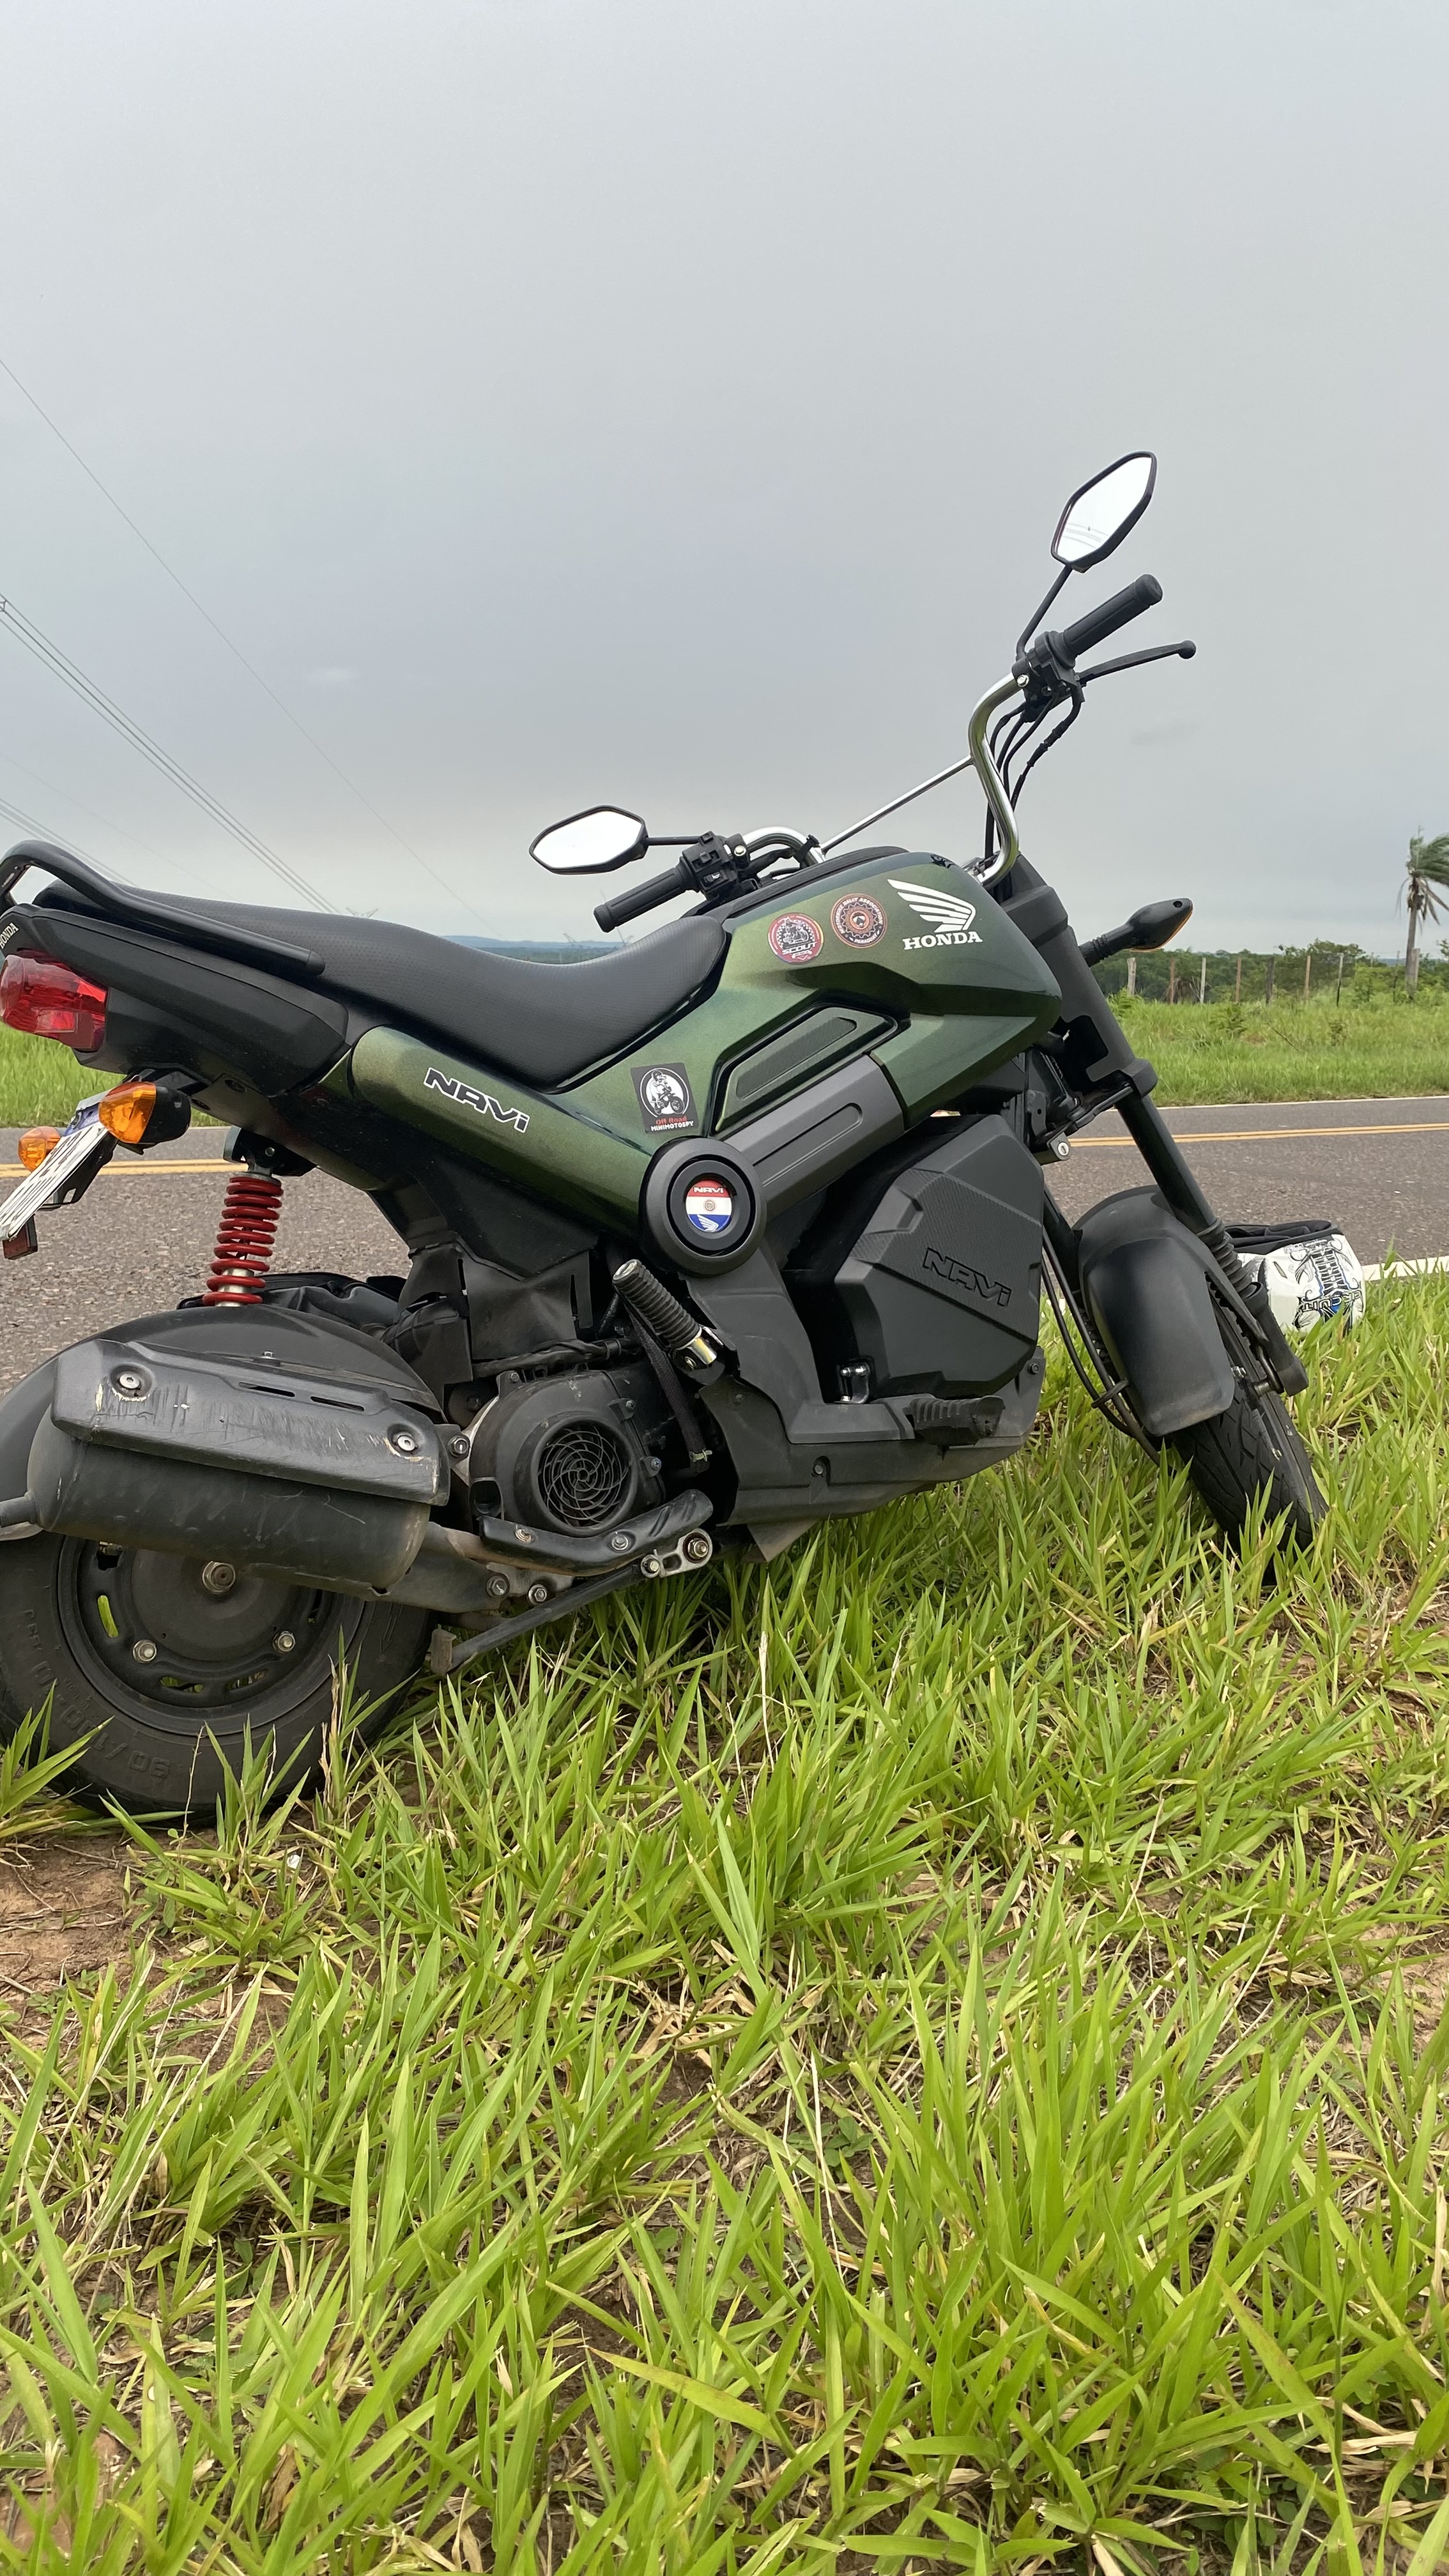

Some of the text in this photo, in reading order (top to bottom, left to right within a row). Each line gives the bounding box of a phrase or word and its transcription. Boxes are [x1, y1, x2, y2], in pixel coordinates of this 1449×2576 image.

[835, 903, 846, 934] MOTORBIKE
[842, 897, 859, 906] RALLY
[859, 898, 883, 925] ASSOCIATION
[854, 932, 878, 944] PARAGUAY
[902, 931, 983, 951] HONDA
[781, 941, 817, 955] SCOUT
[650, 1120, 694, 1131] MINIMOTOSPY
[668, 1115, 688, 1124] Road
